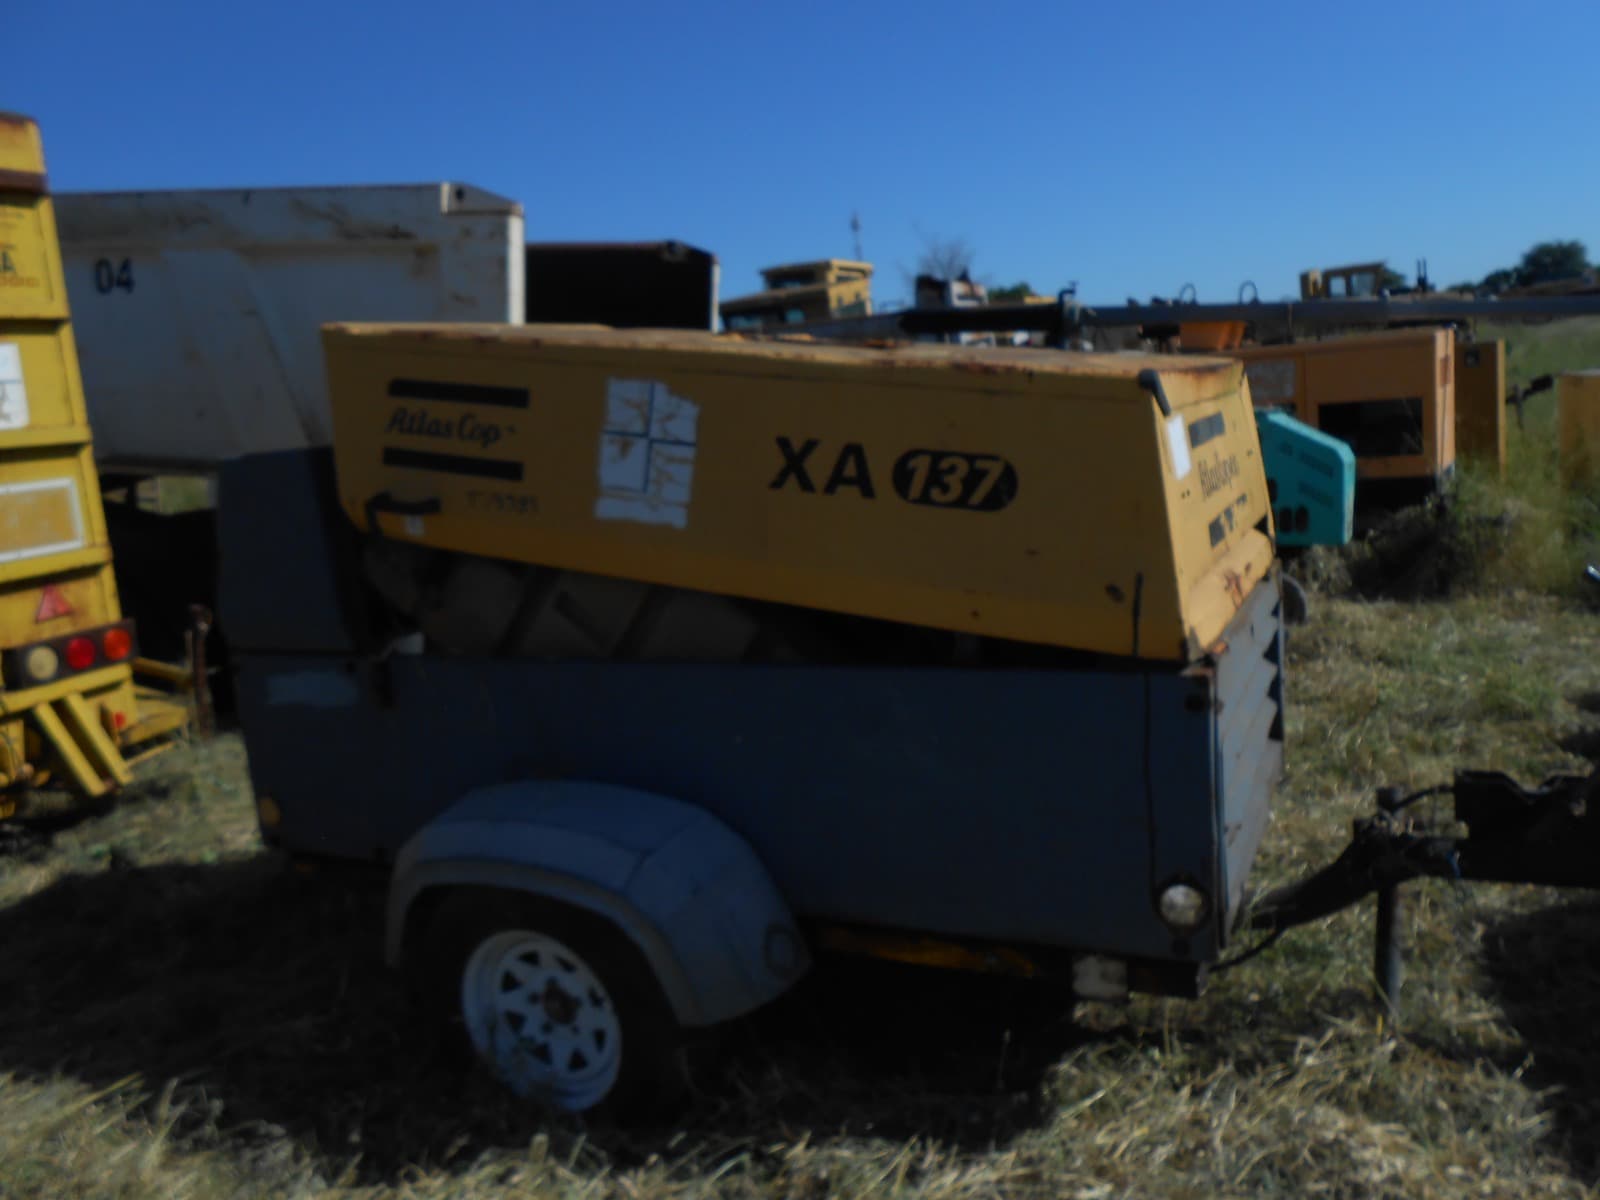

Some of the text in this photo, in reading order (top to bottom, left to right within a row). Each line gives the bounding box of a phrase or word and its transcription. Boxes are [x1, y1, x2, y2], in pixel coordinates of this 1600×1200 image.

[94, 258, 134, 294] 04
[384, 406, 454, 438] Atlas
[769, 436, 1006, 508] XA 137
